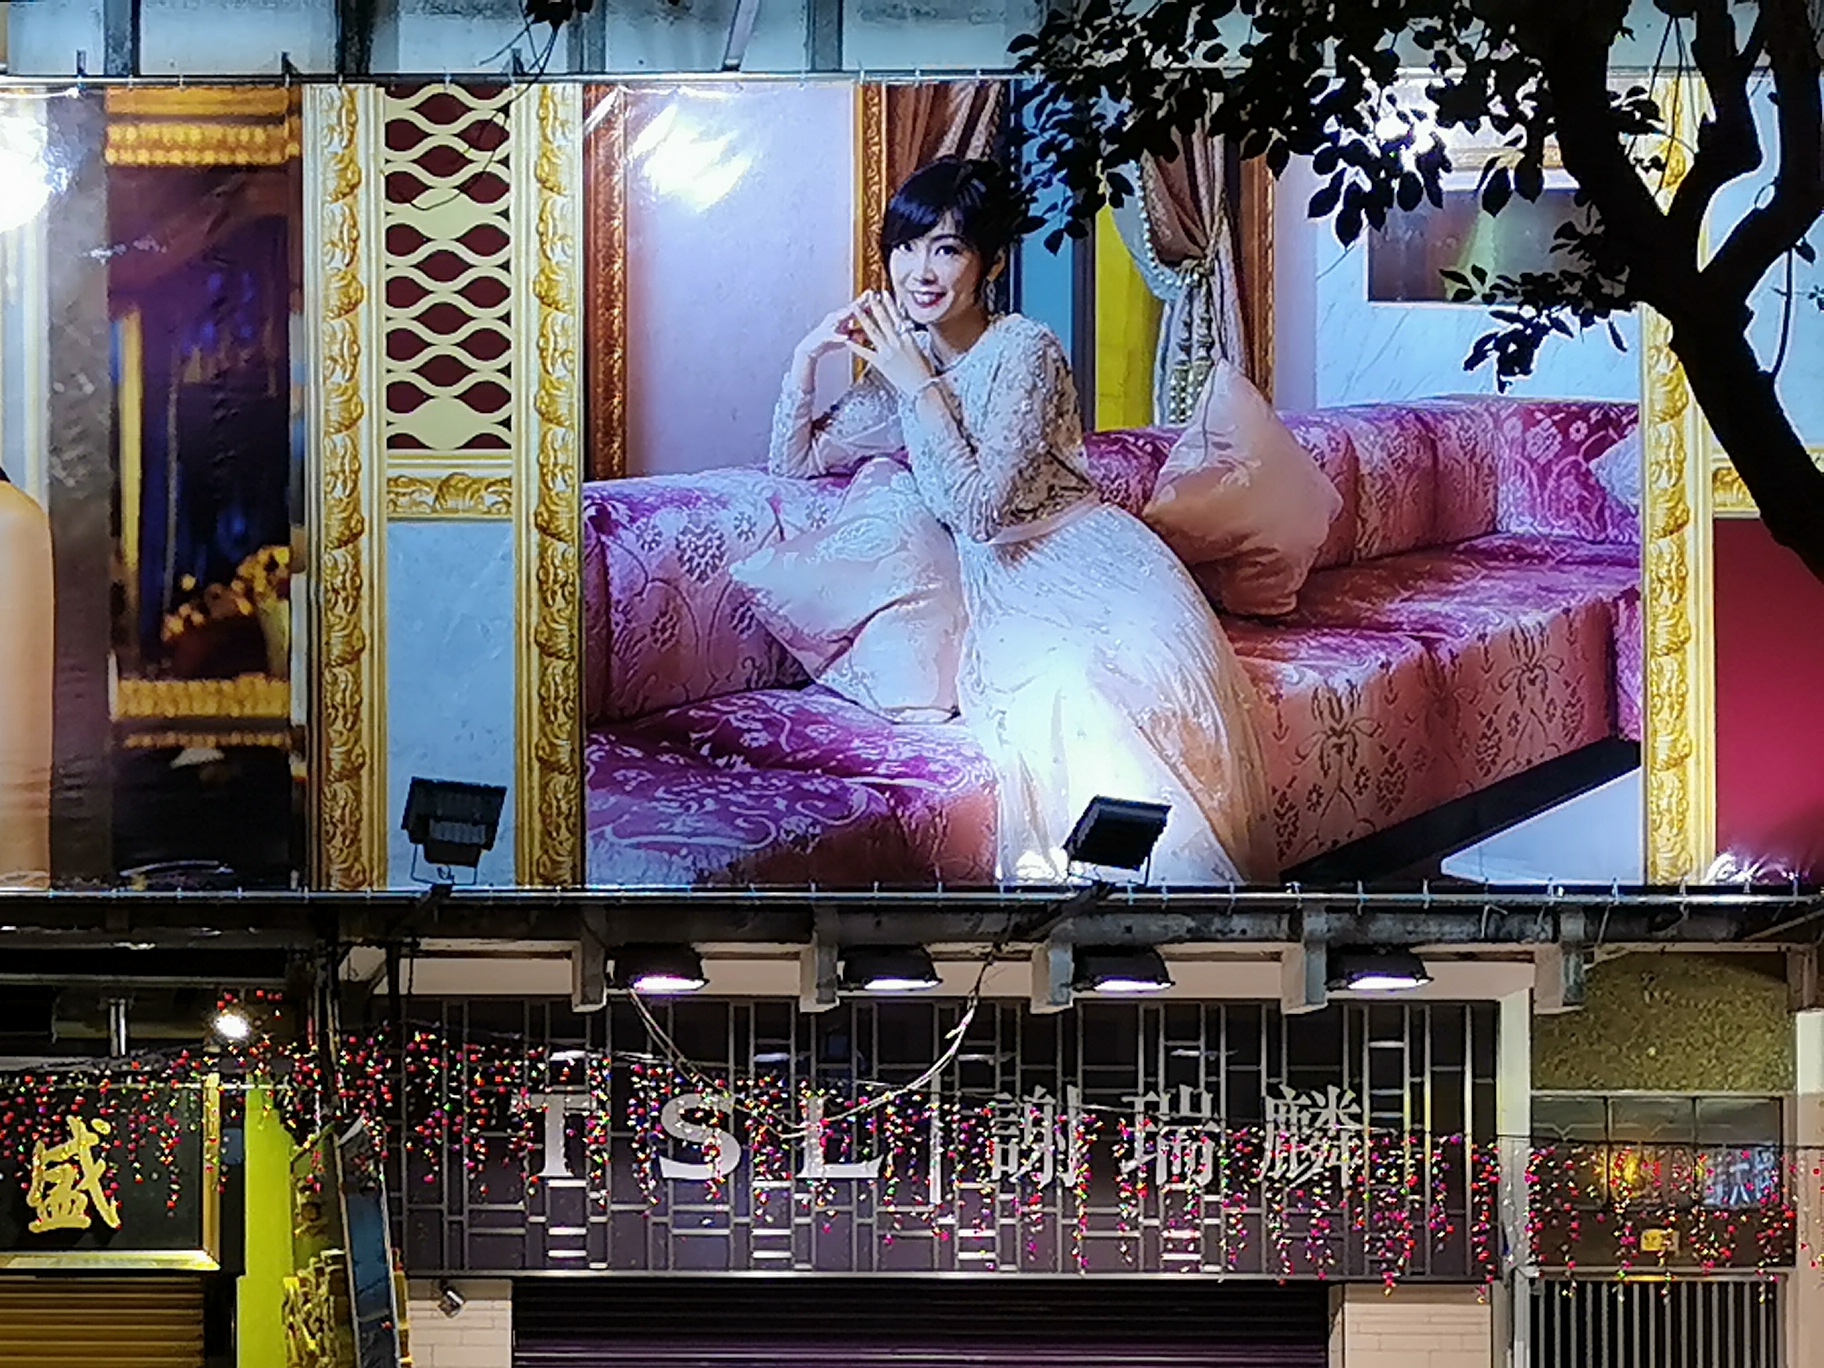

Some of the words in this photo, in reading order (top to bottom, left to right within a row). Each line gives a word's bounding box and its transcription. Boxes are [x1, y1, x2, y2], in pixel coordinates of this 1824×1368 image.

[511, 1091, 887, 1181] TSL
[987, 1084, 1365, 1187] 謝瑞麟
